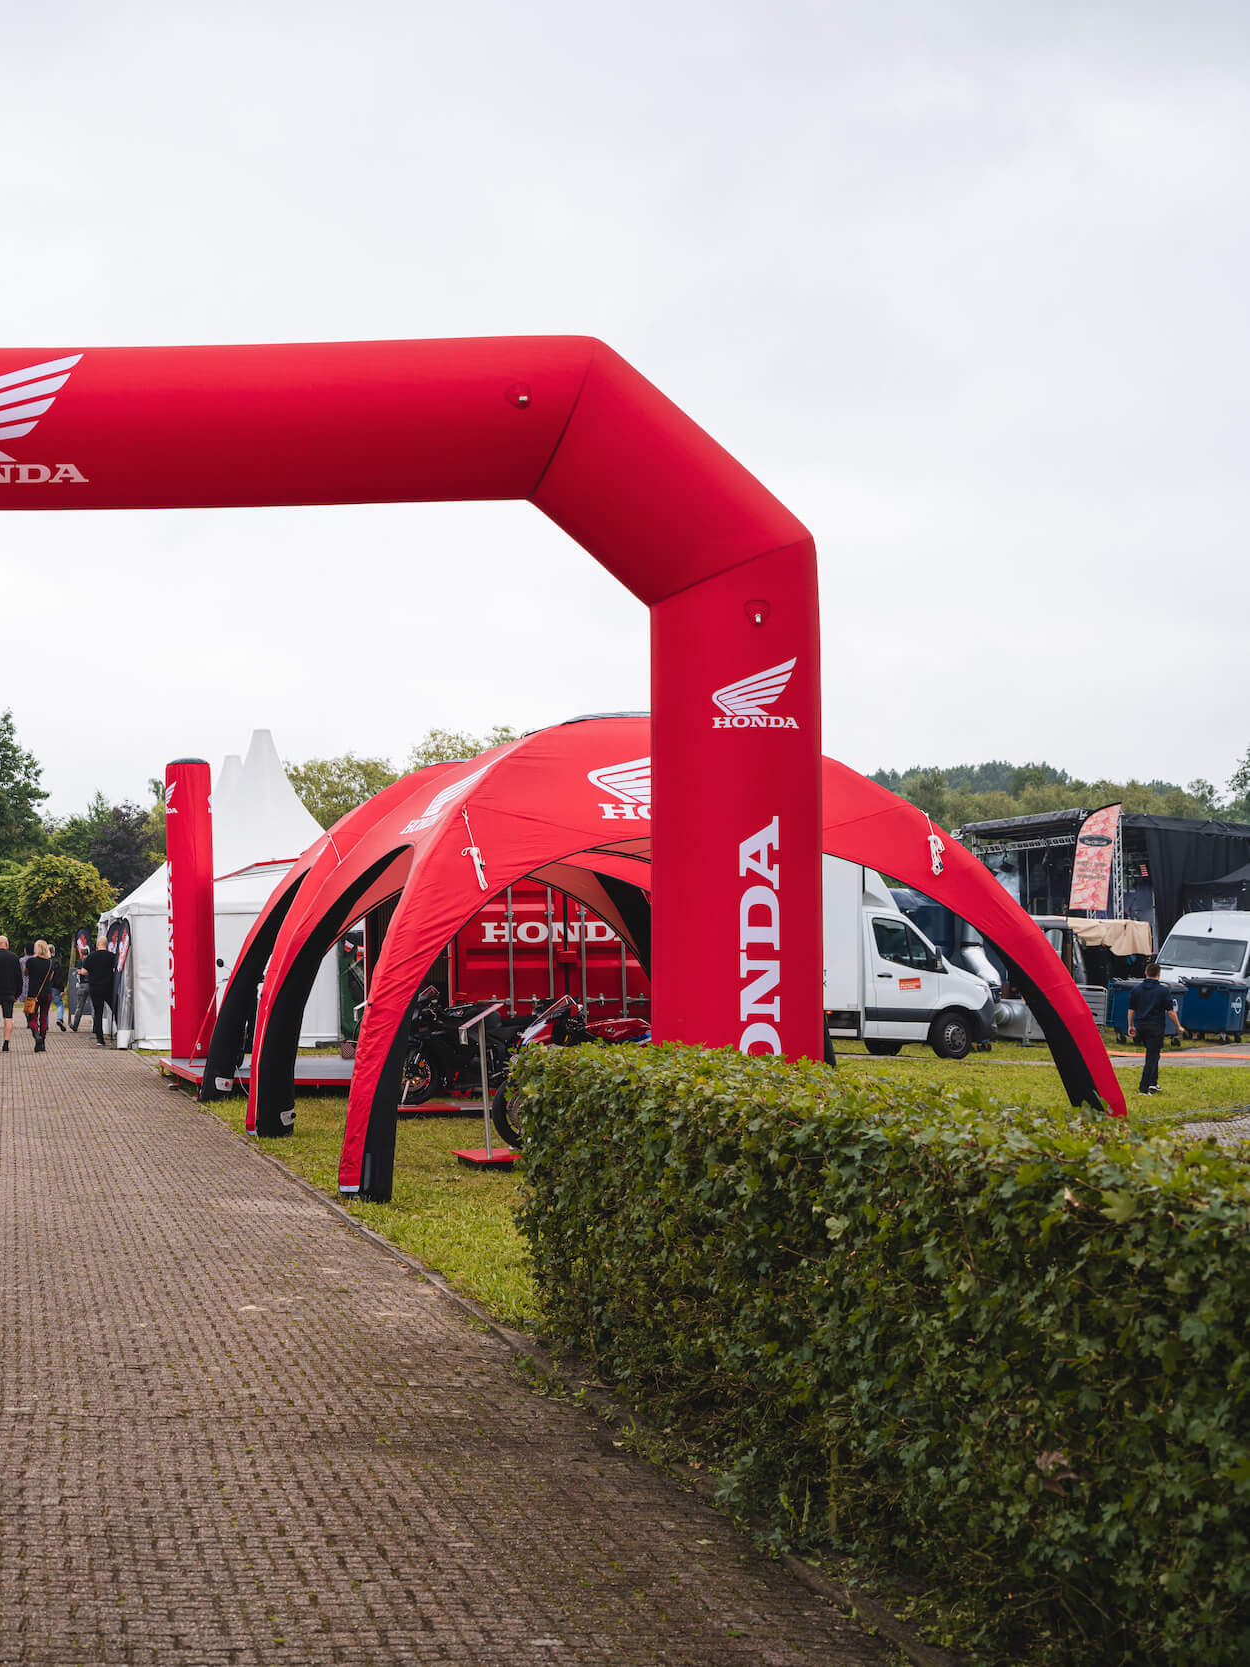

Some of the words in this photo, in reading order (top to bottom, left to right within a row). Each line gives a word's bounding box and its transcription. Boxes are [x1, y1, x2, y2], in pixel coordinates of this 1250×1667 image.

[712, 716, 799, 730] HONDA
[481, 921, 622, 943] HOND
[739, 816, 781, 1056] ONDA
